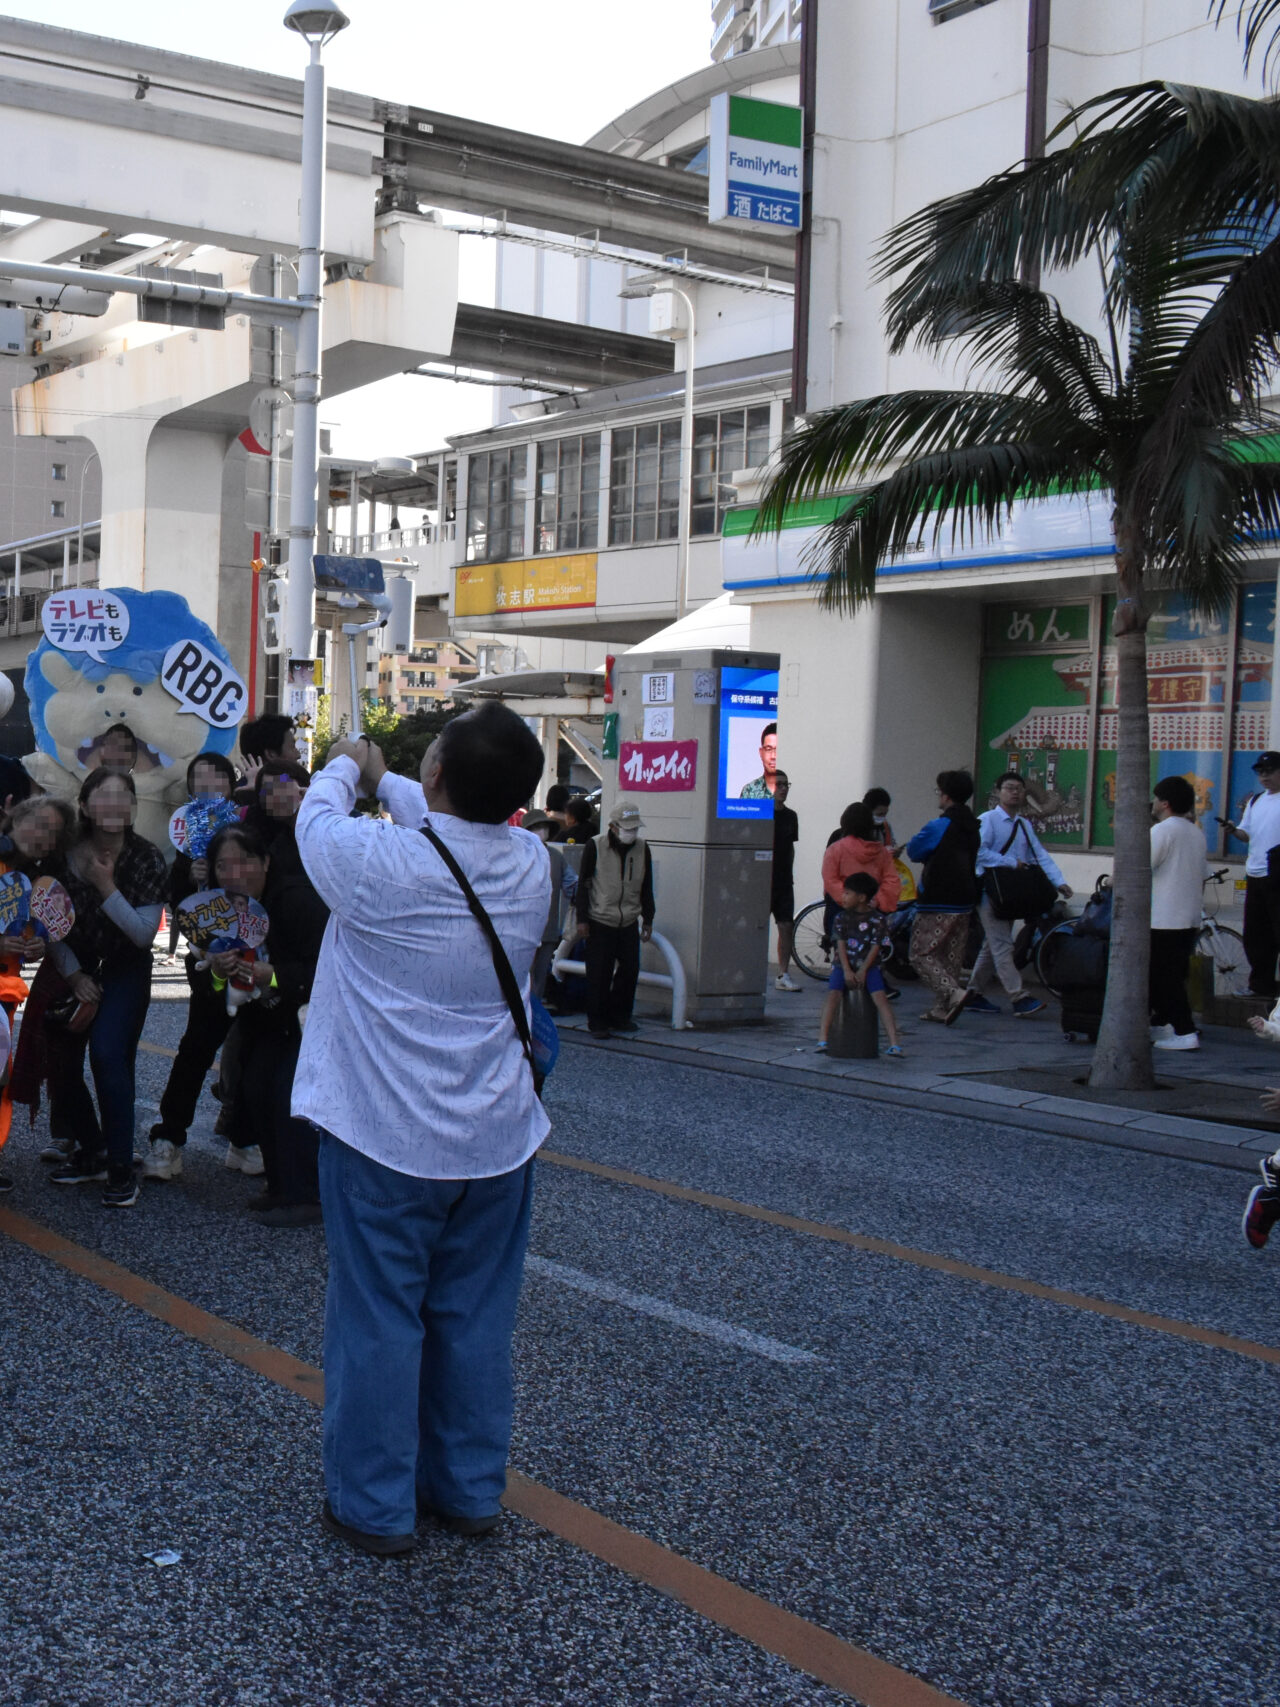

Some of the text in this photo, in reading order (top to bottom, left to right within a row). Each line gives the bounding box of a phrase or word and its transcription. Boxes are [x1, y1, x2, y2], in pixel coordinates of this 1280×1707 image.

[729, 151, 798, 178] FamilyMart
[733, 194, 793, 223] 酒 たばこ
[49, 599, 120, 620] テレビも
[496, 587, 536, 608] 牧志駅
[50, 622, 123, 643] ラジオも
[164, 641, 244, 723] RBC
[178, 896, 231, 928] キャラメル
